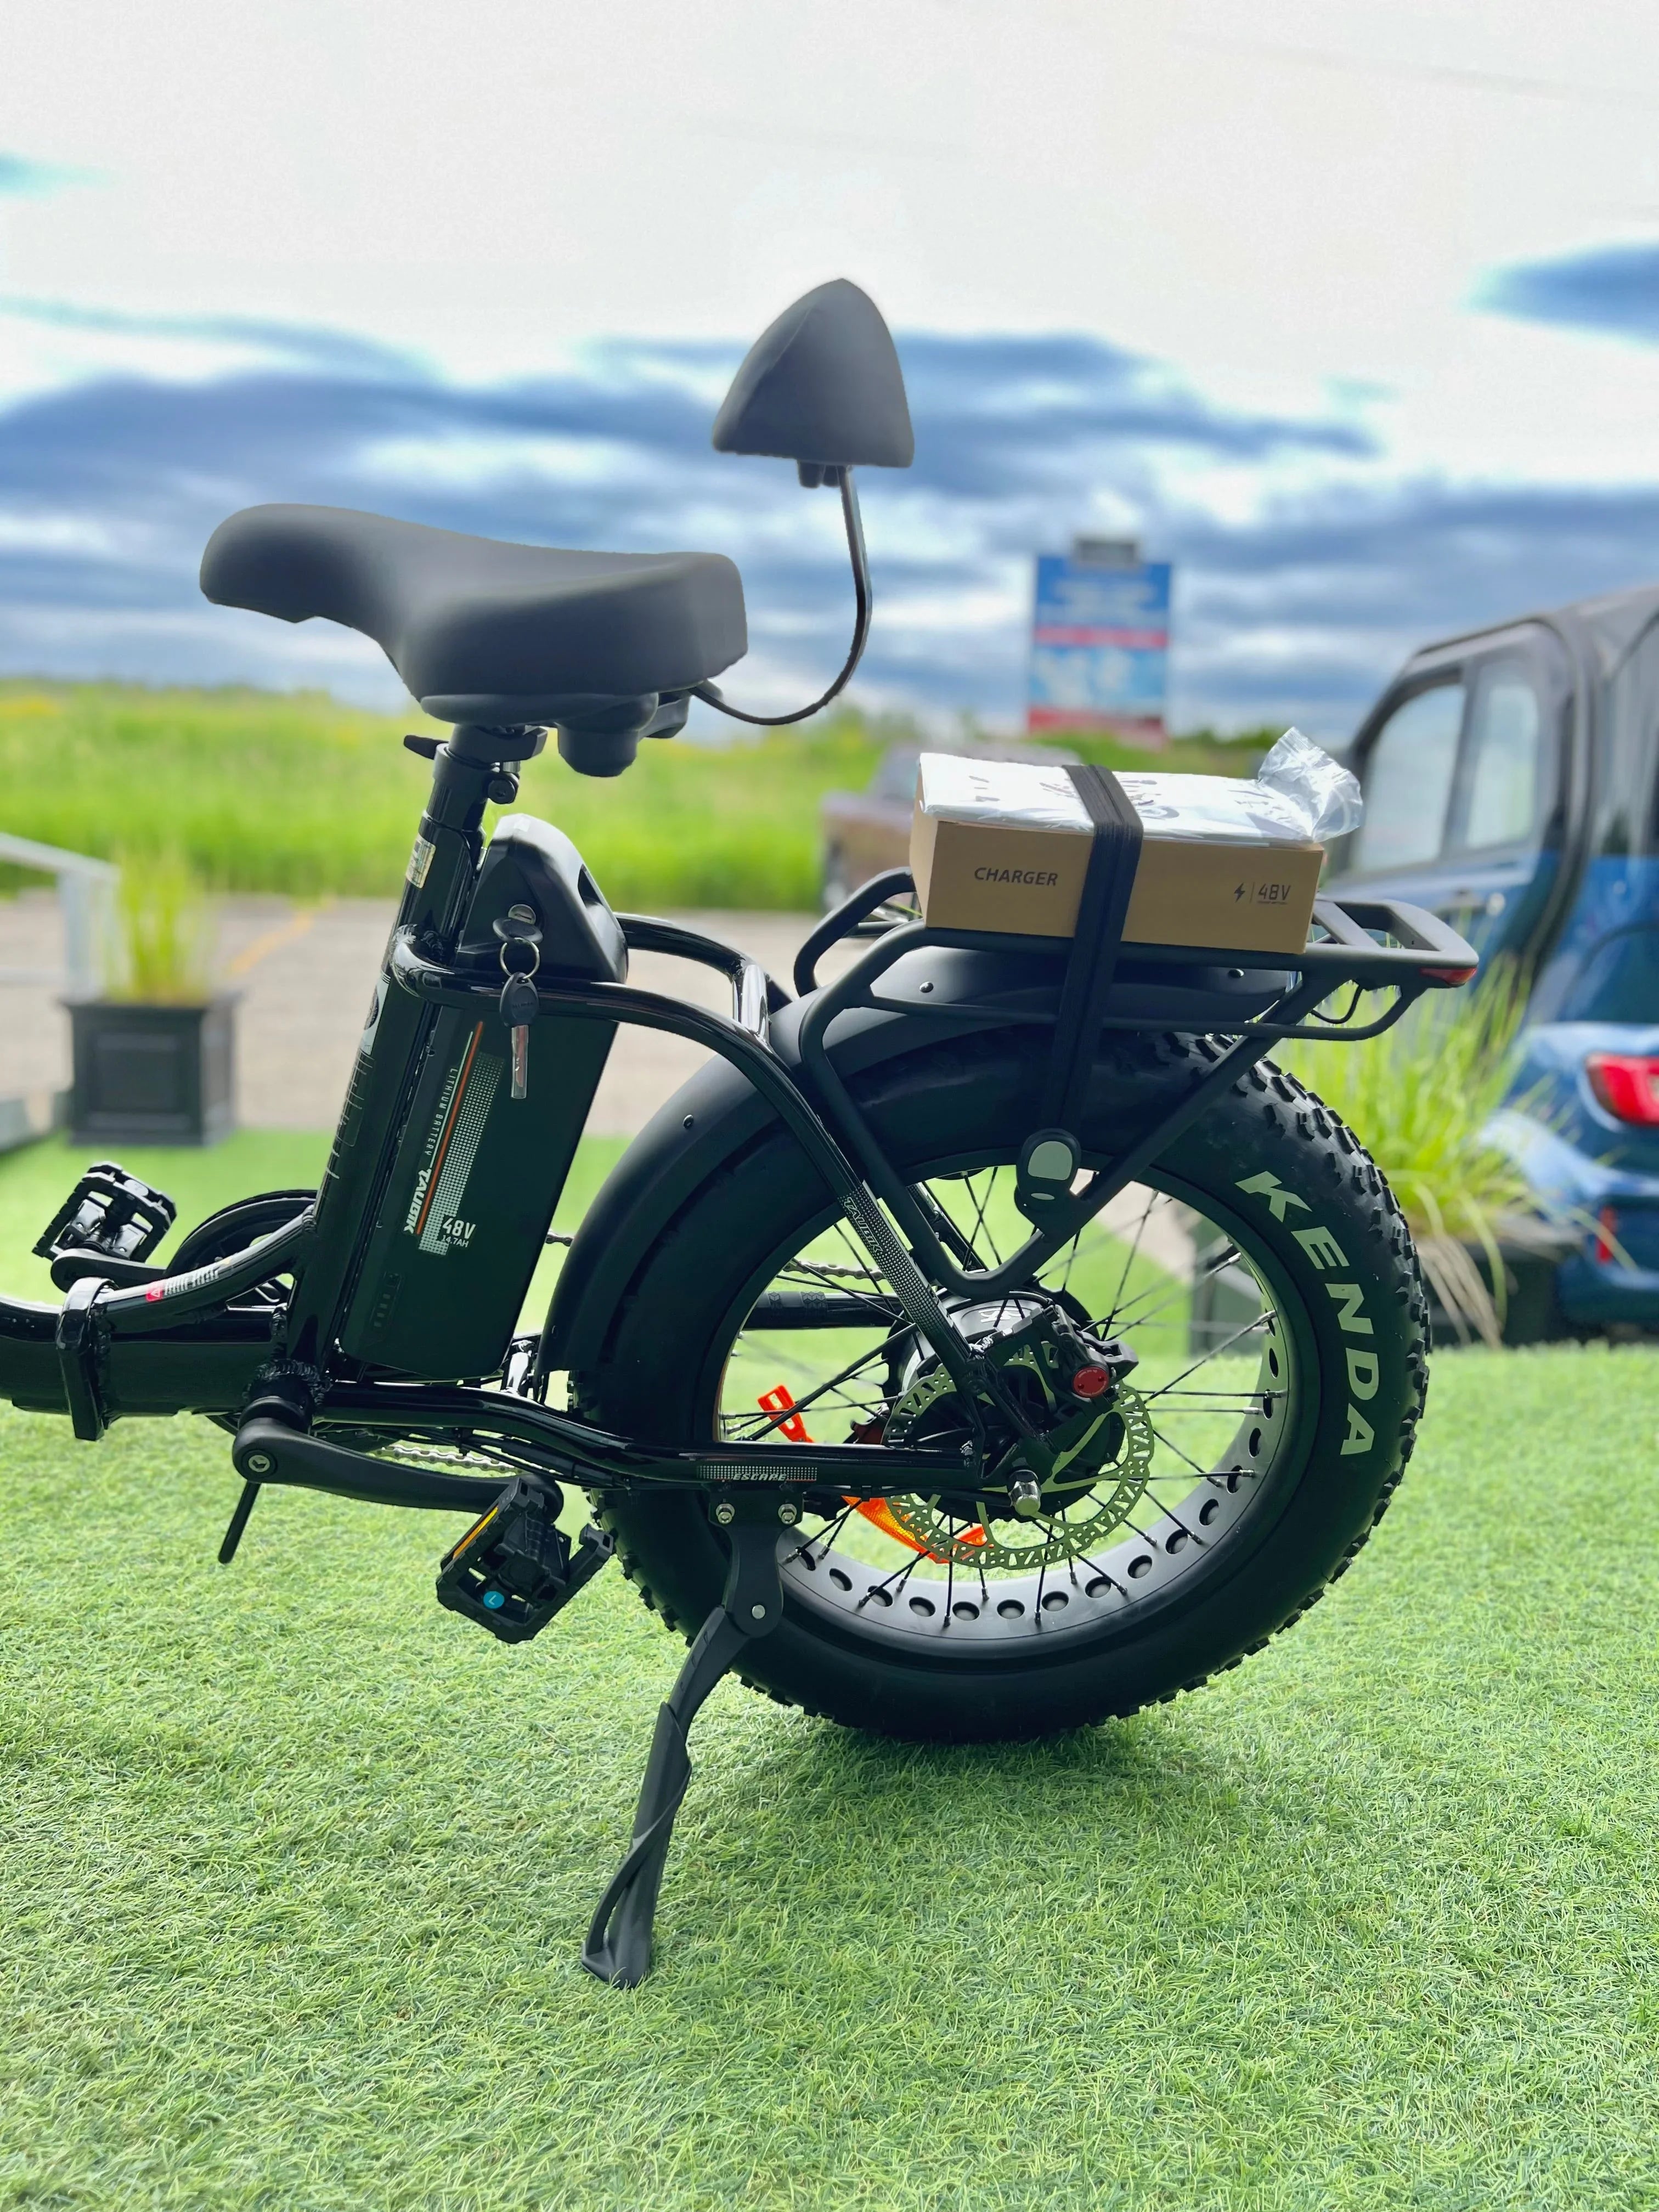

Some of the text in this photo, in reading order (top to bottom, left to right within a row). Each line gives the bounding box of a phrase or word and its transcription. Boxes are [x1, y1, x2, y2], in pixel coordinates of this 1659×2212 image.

[974, 867, 1058, 886] CHARGER
[1258, 883, 1291, 901] 48V
[424, 1068, 459, 1156] LITHIUM BATTERY
[403, 1168, 432, 1234] TAUBIK
[442, 1217, 477, 1239] 48V
[844, 1197, 884, 1253] TAUBIK
[441, 1234, 470, 1248] 14.7AH
[1234, 1170, 1380, 1456] KENDA
[732, 1473, 787, 1481] ESCAPE
